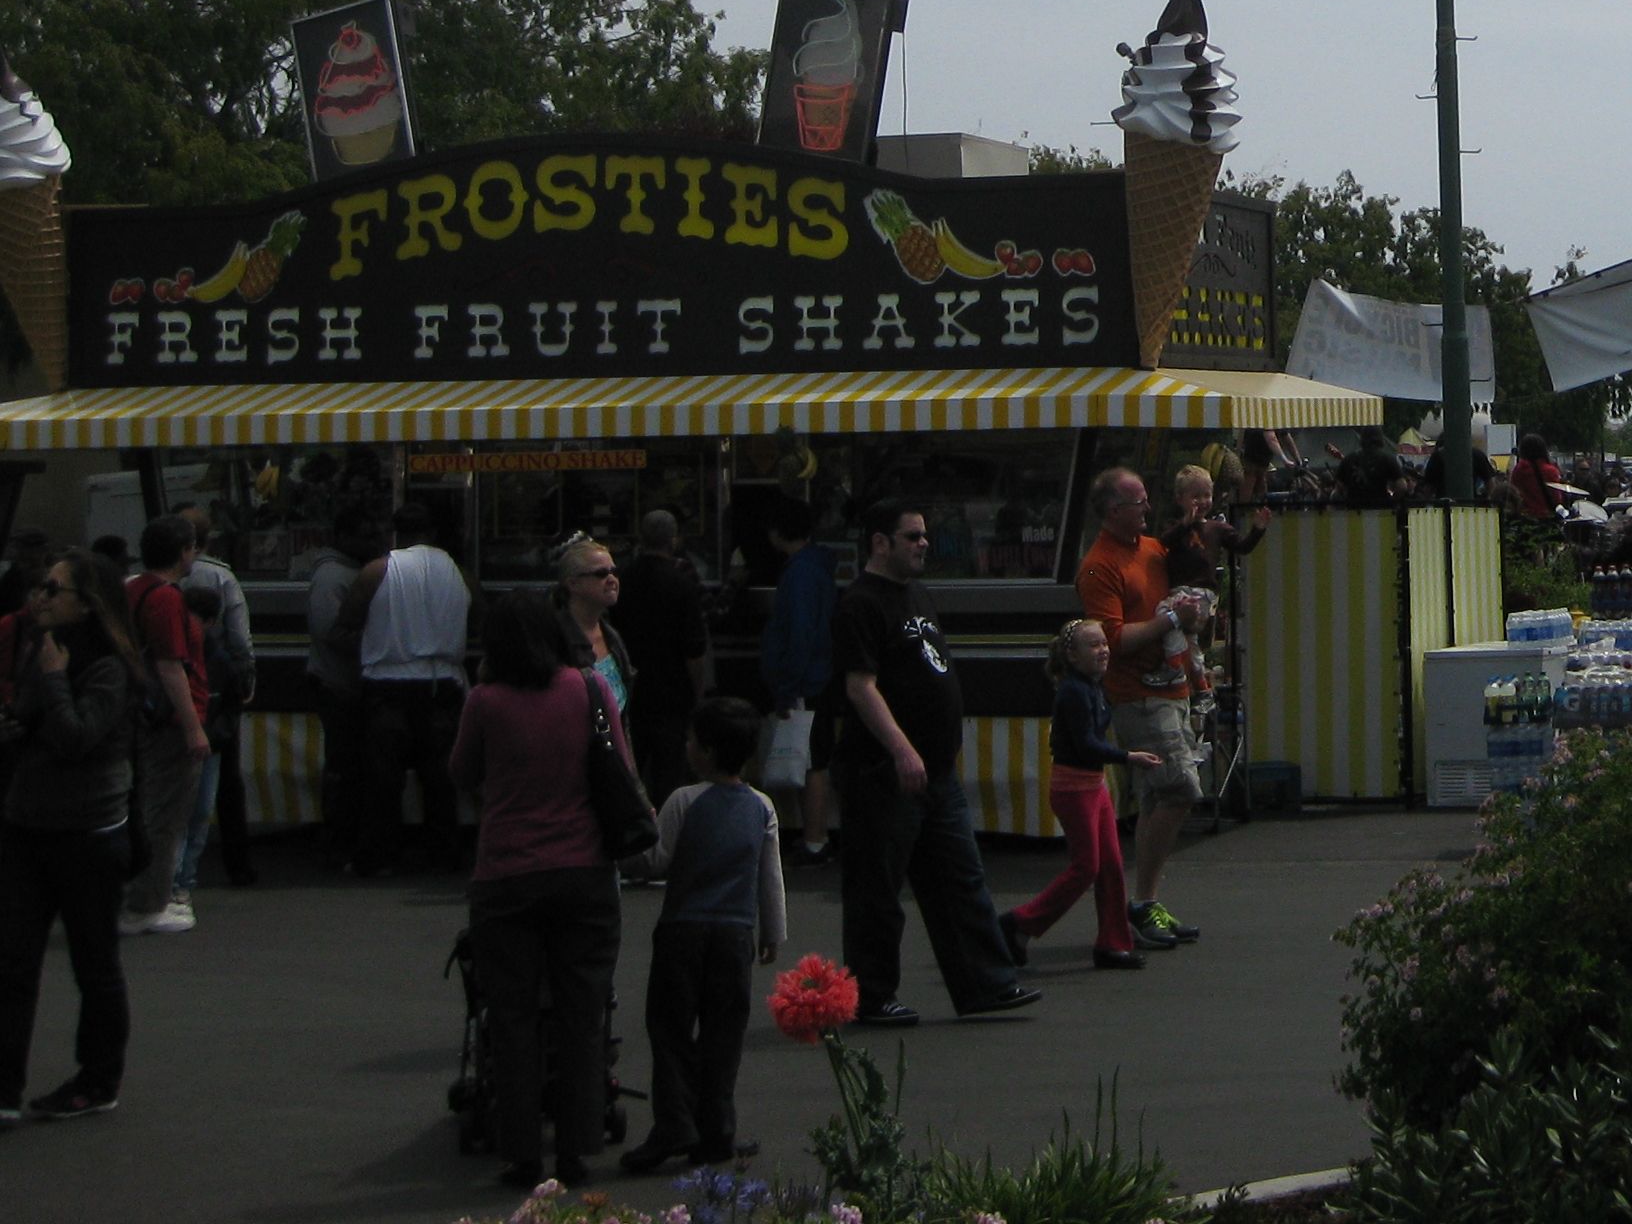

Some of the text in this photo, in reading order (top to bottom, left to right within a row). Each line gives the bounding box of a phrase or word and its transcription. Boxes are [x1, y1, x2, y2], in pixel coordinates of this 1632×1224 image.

[331, 155, 849, 282] FROSTIES
[106, 285, 1099, 366] FRESH FRUIT SHAKES
[1171, 286, 1266, 351] HAKES
[409, 451, 645, 473] CAPPUCCINO SHAKE
